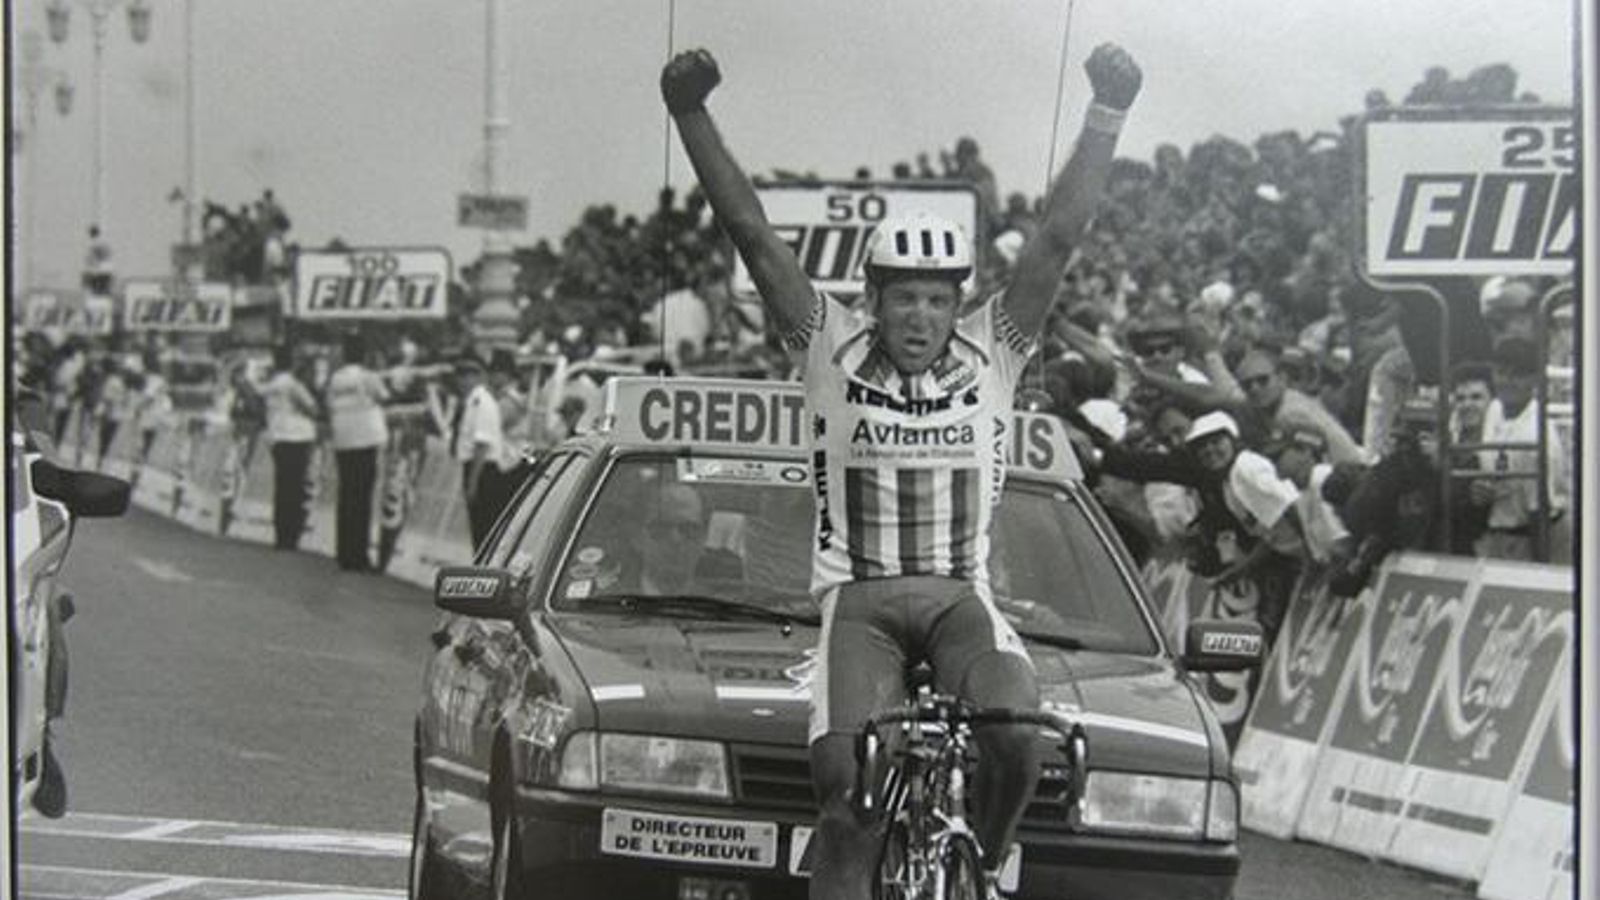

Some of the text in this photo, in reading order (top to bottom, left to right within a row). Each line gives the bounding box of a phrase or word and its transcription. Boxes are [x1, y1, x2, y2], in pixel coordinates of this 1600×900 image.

[826, 195, 887, 222] 50
[309, 275, 439, 309] FIAT
[131, 299, 222, 326] FIAT
[639, 388, 806, 446] CREDIT
[850, 418, 975, 446] Avianca
[631, 817, 747, 841] DIRECTEUR
[615, 835, 643, 851] DE
